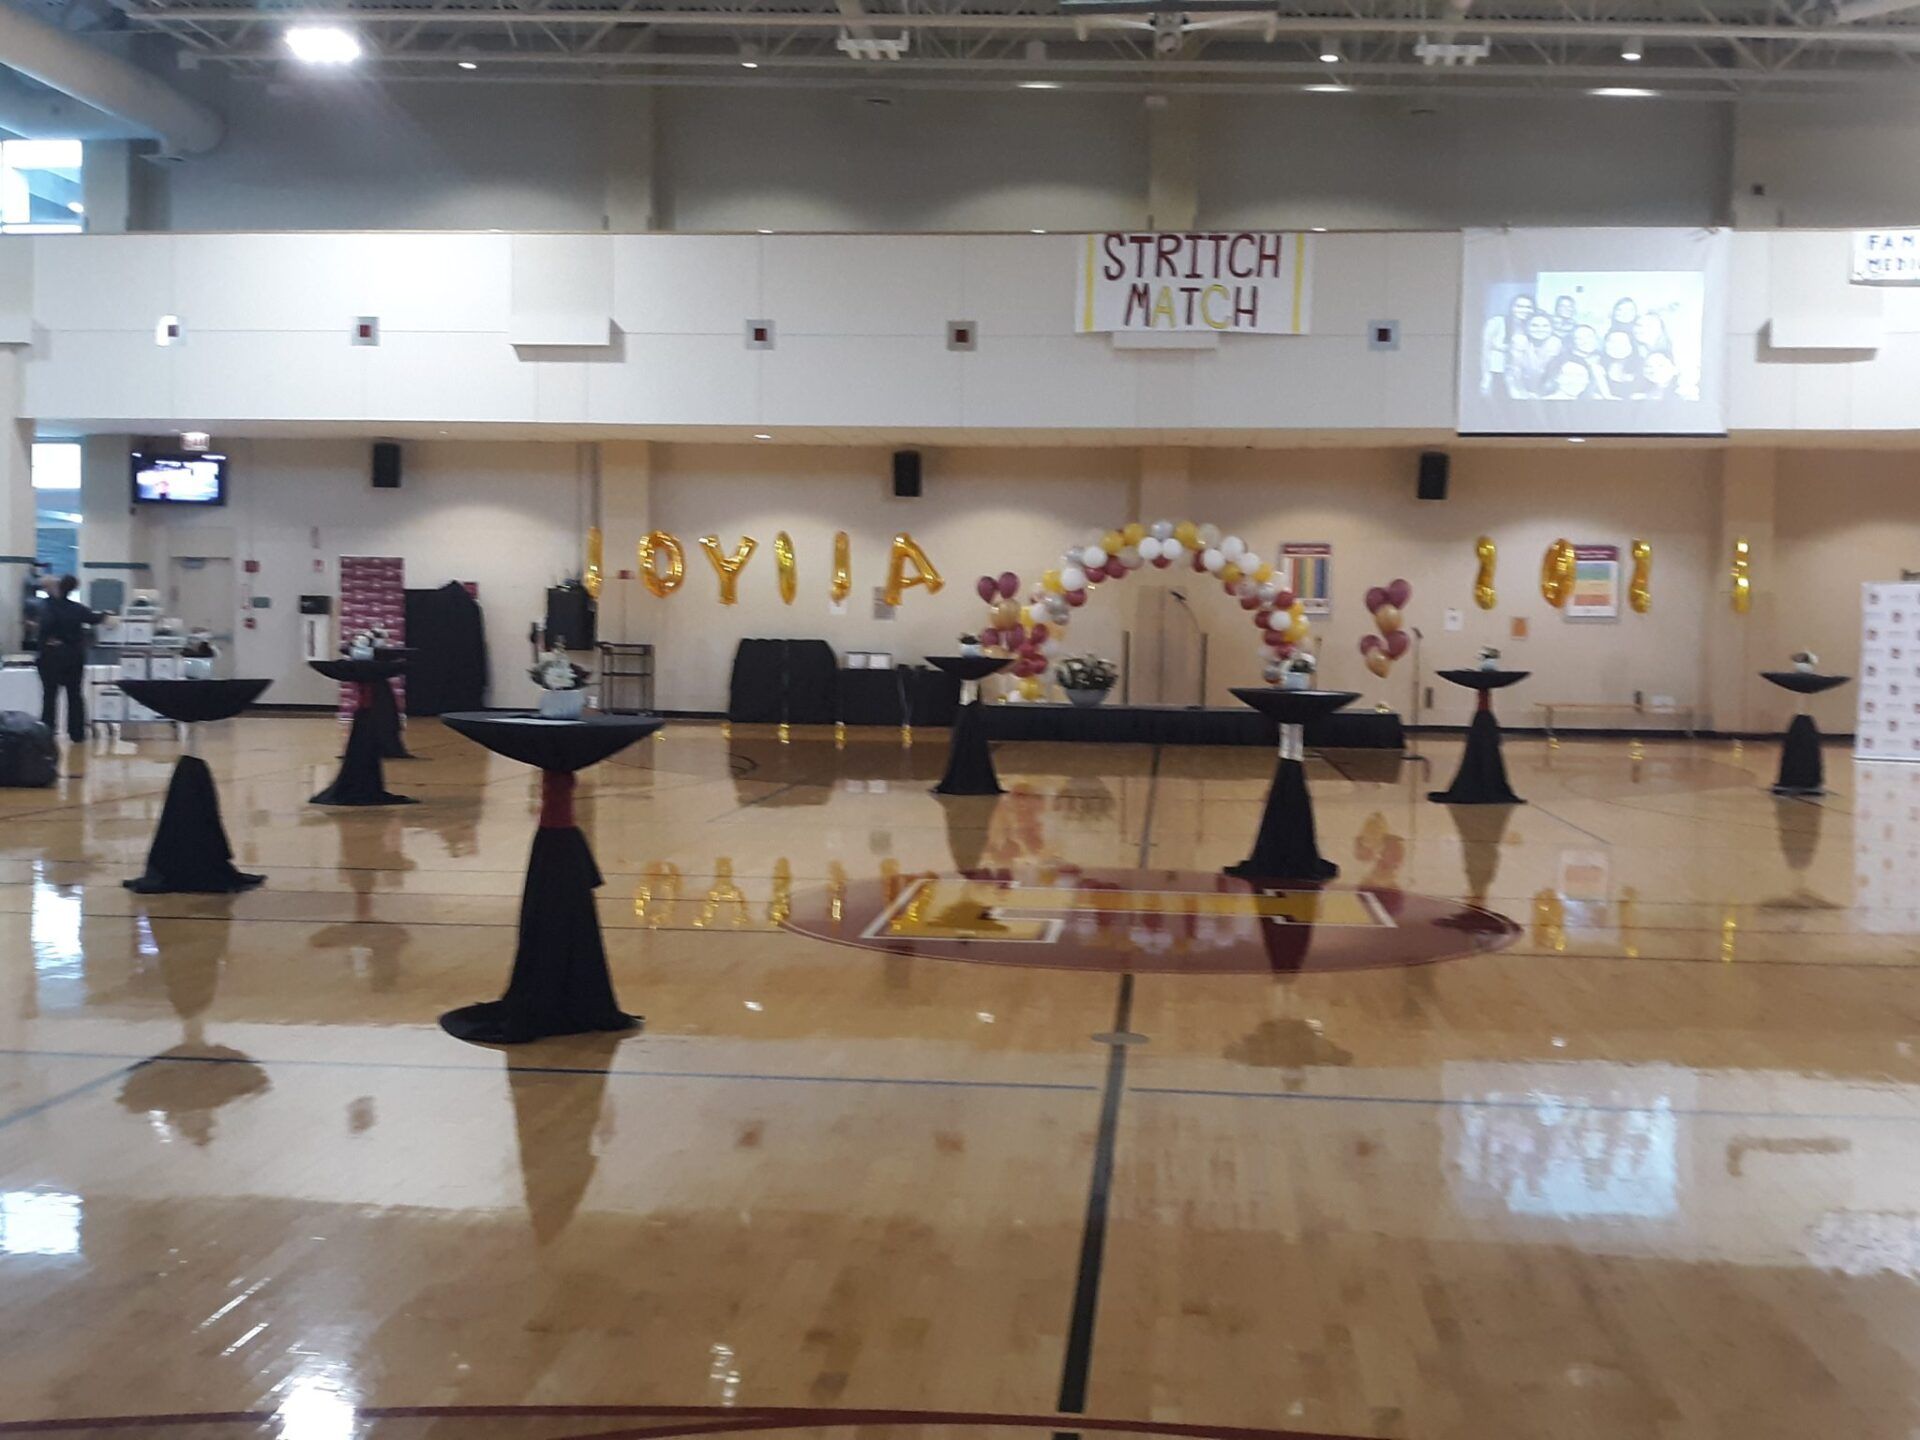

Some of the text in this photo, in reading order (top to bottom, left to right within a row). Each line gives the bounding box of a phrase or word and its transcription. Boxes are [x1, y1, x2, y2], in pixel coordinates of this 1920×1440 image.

[1104, 232, 1282, 281] STRITCH
[1867, 257, 1920, 271] MEDI
[1124, 283, 1258, 329] MATCH
